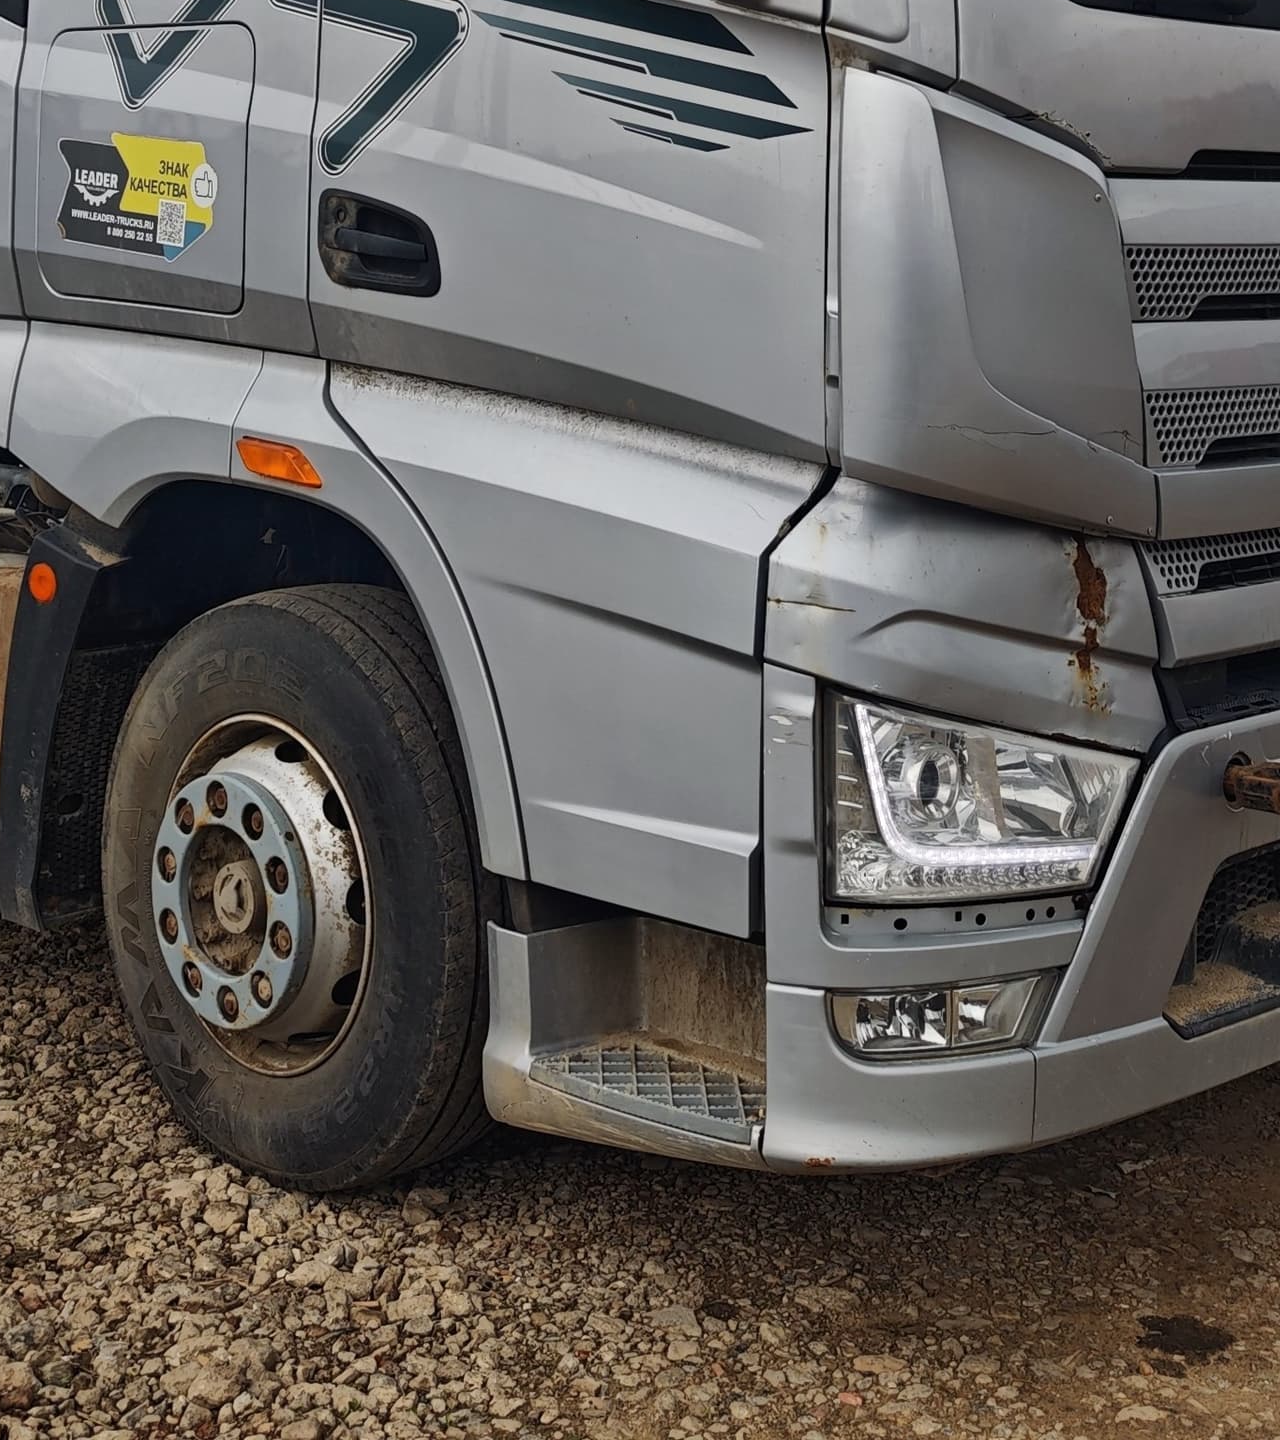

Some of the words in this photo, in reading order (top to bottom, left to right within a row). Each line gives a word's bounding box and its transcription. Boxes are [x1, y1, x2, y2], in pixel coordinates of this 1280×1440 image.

[74, 168, 119, 189] LEADER
[159, 160, 190, 178] ЗНАК
[129, 177, 188, 199] КАЧЕСТВА
[71, 208, 154, 230] WWW.LEADER-TRUCKS.RU
[136, 231, 145, 241] 22
[145, 233, 153, 243] 55
